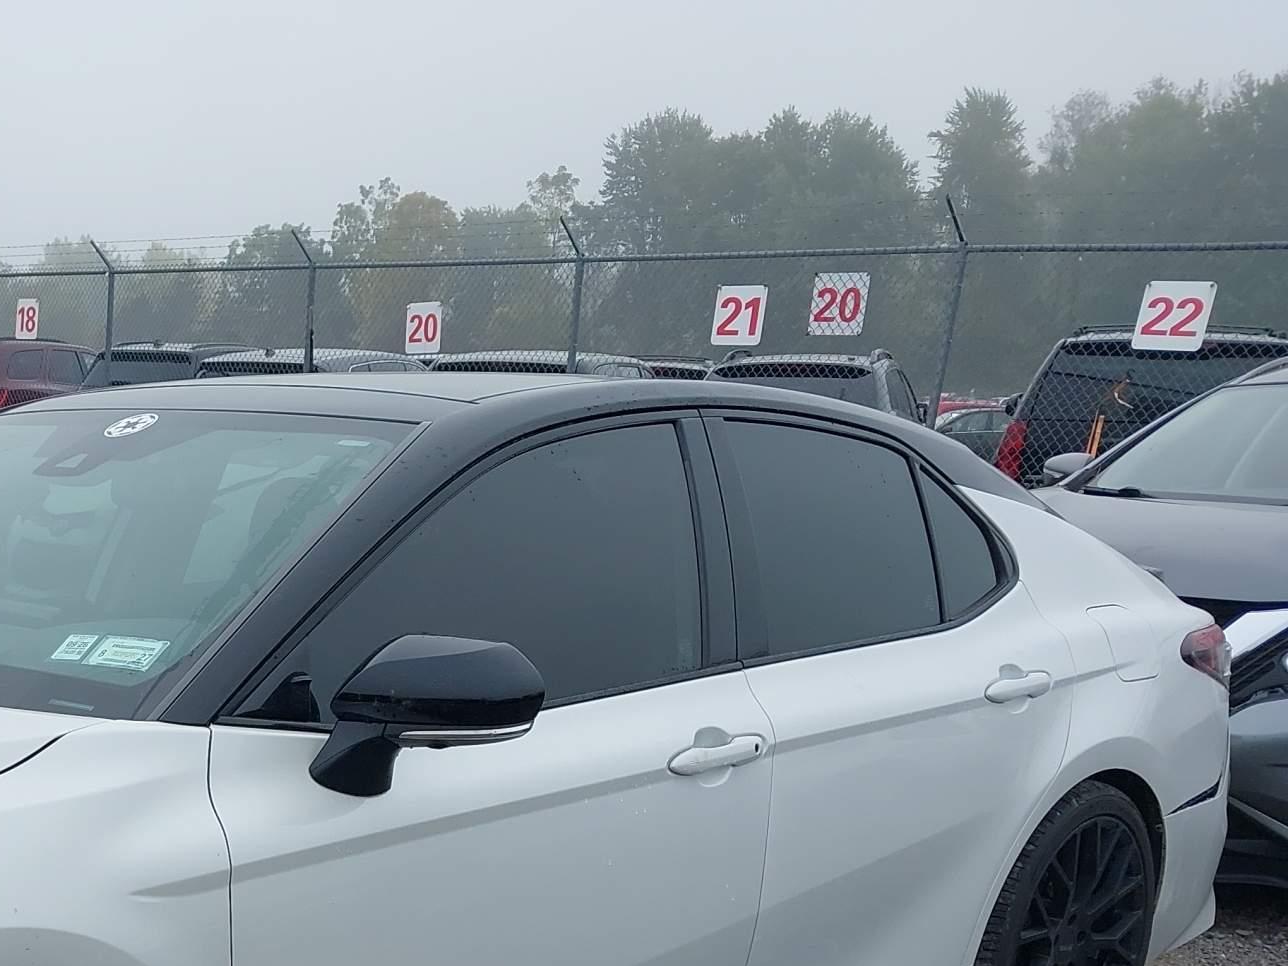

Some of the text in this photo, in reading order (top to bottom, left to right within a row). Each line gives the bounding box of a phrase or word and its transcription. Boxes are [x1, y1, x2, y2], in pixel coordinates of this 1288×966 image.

[17, 306, 37, 333] 18
[716, 296, 762, 337] 21
[813, 287, 862, 324] 20
[1140, 296, 1204, 337] 22
[408, 314, 438, 343] 20
[136, 653, 153, 662] 27
